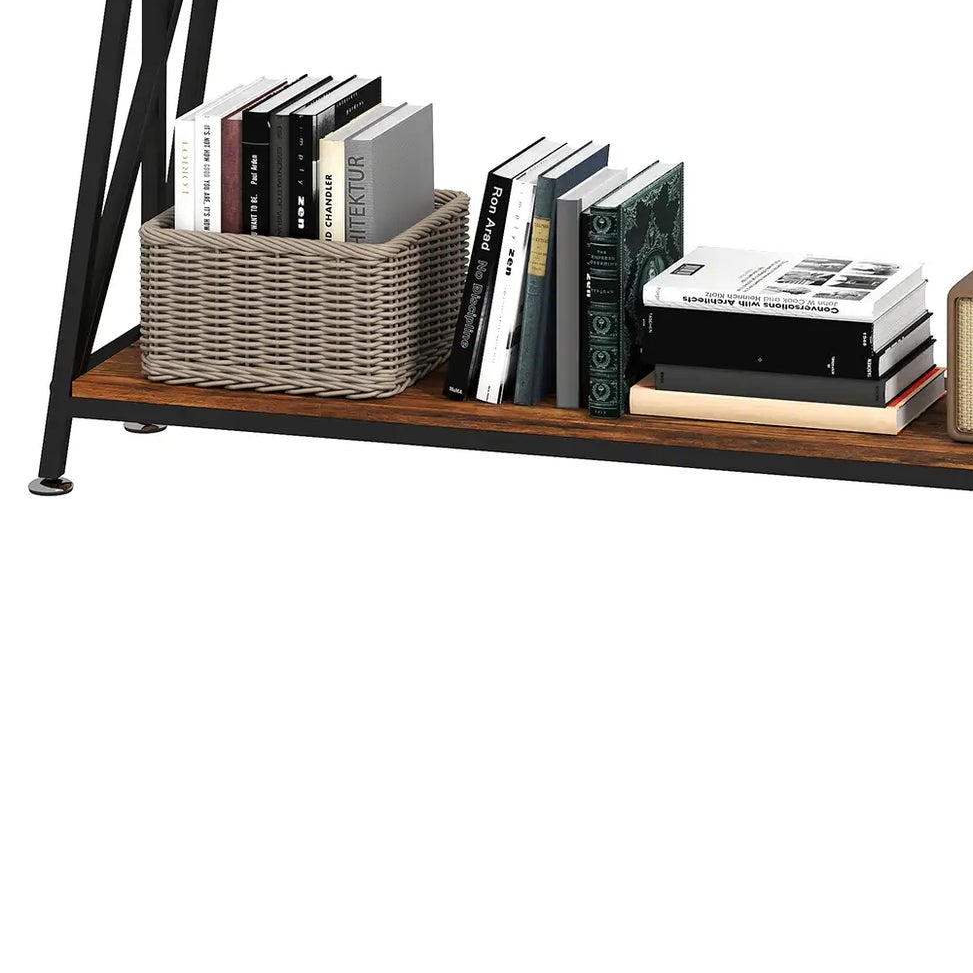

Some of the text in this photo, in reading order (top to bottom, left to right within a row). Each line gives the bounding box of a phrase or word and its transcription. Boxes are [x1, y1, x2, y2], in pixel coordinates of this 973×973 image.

[203, 124, 211, 136] IT'S
[203, 137, 211, 148] NOT
[203, 149, 211, 162] HOW
[250, 154, 258, 171] Arden
[250, 172, 258, 185] Paul
[203, 180, 211, 191] YOU
[203, 192, 211, 205] ARE,
[250, 194, 258, 204] BE.
[325, 174, 333, 229] CHANDLER
[203, 206, 211, 217] IT'S
[297, 195, 305, 230] zen
[203, 218, 211, 231] HOW
[250, 214, 258, 231] WANT
[460, 186, 503, 349] Ron Arad No Discipline
[505, 249, 515, 276] zen
[705, 291, 725, 299] Klotz
[727, 293, 761, 302] Heinrich
[682, 295, 839, 314] Conversations with Architects
